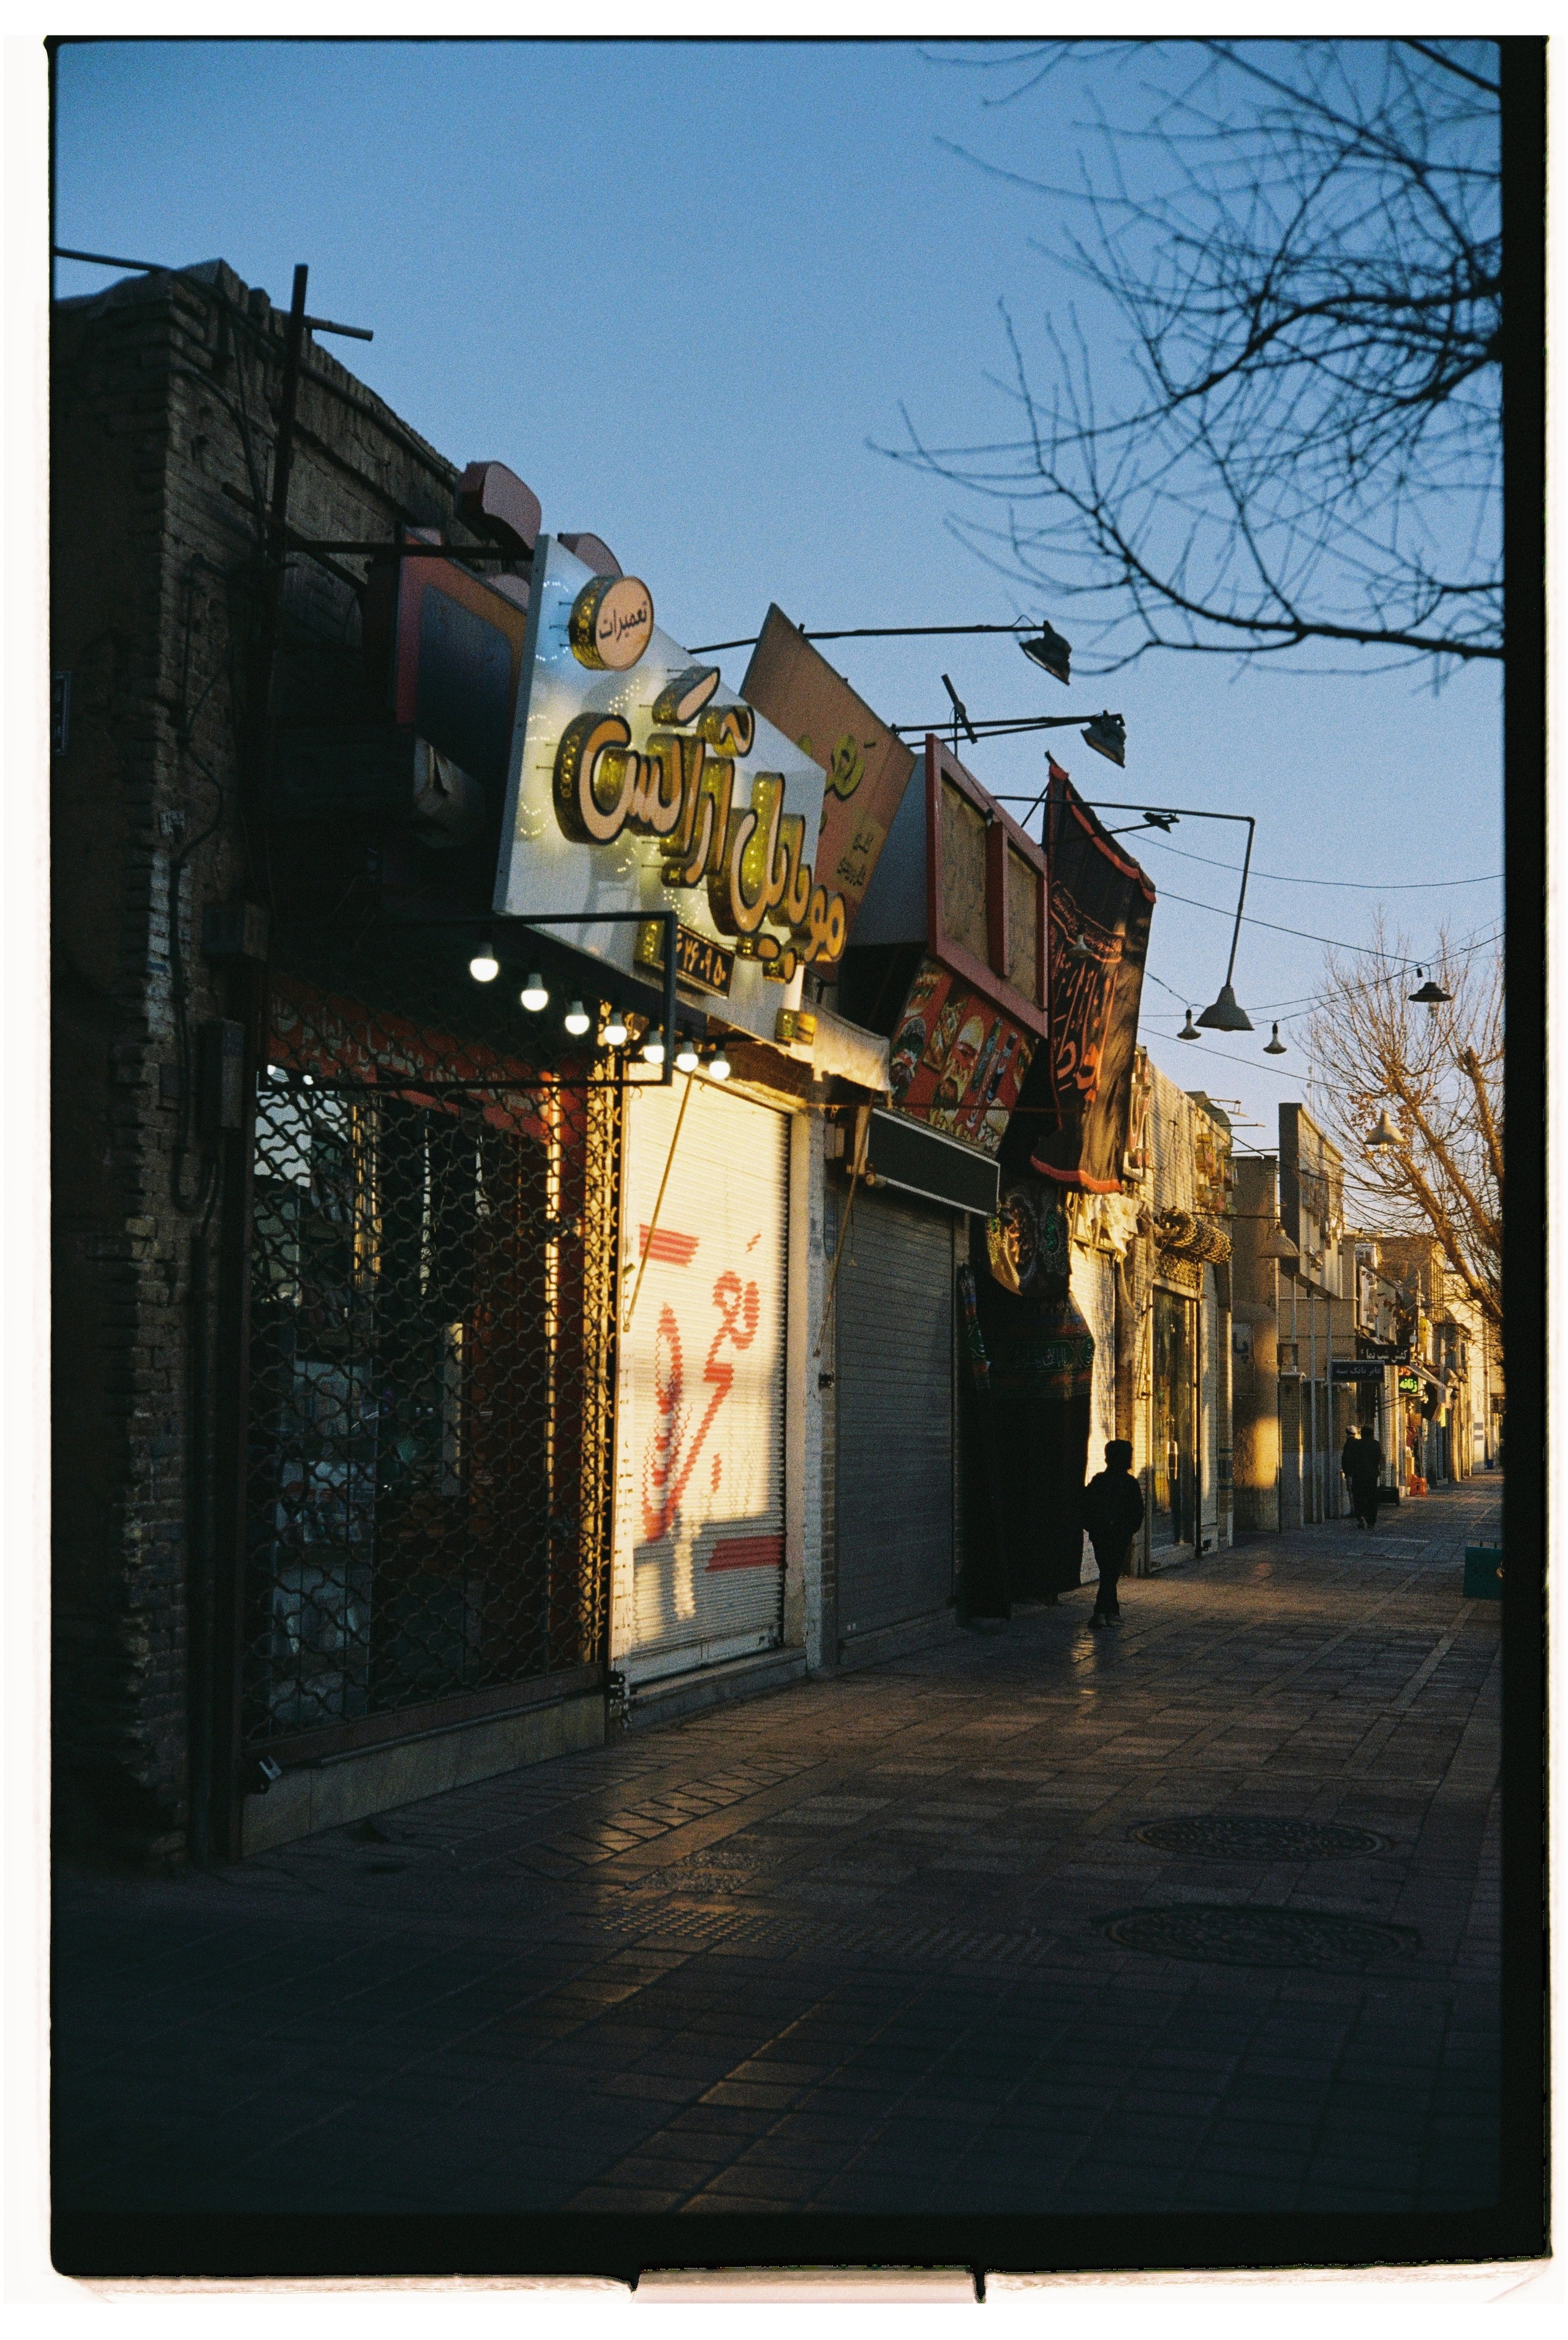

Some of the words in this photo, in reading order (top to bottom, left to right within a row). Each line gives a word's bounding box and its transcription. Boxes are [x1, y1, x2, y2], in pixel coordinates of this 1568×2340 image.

[599, 600, 647, 642] تعمیرات
[722, 772, 846, 984] موبایل
[1391, 1349, 1408, 1363] کفش
[1349, 1366, 1366, 1376] بانک
[1400, 1378, 1418, 1392] زنانه
